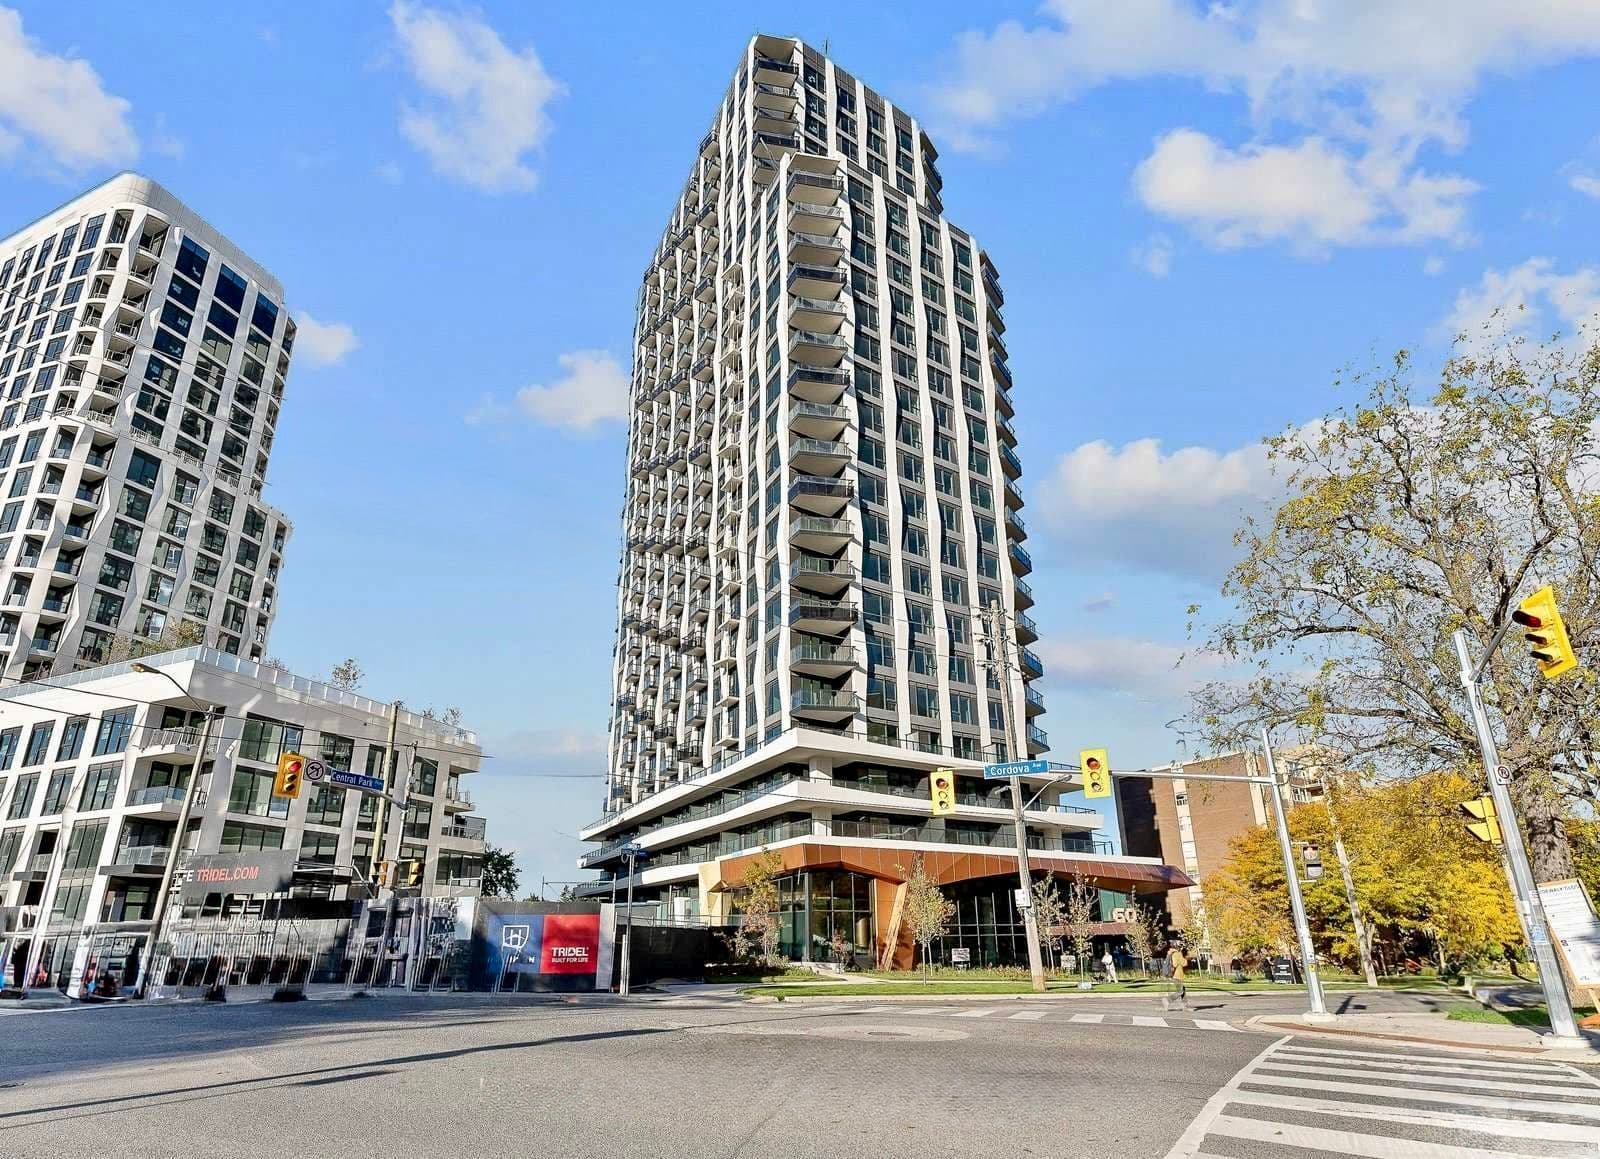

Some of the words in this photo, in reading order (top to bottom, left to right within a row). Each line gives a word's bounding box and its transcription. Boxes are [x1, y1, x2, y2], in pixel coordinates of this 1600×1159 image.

[990, 765, 1030, 776] Cordova
[332, 772, 356, 784] Central
[358, 777, 372, 787] Park
[196, 866, 260, 882] TRIDEL.COM
[552, 947, 588, 956] TRIDEL
